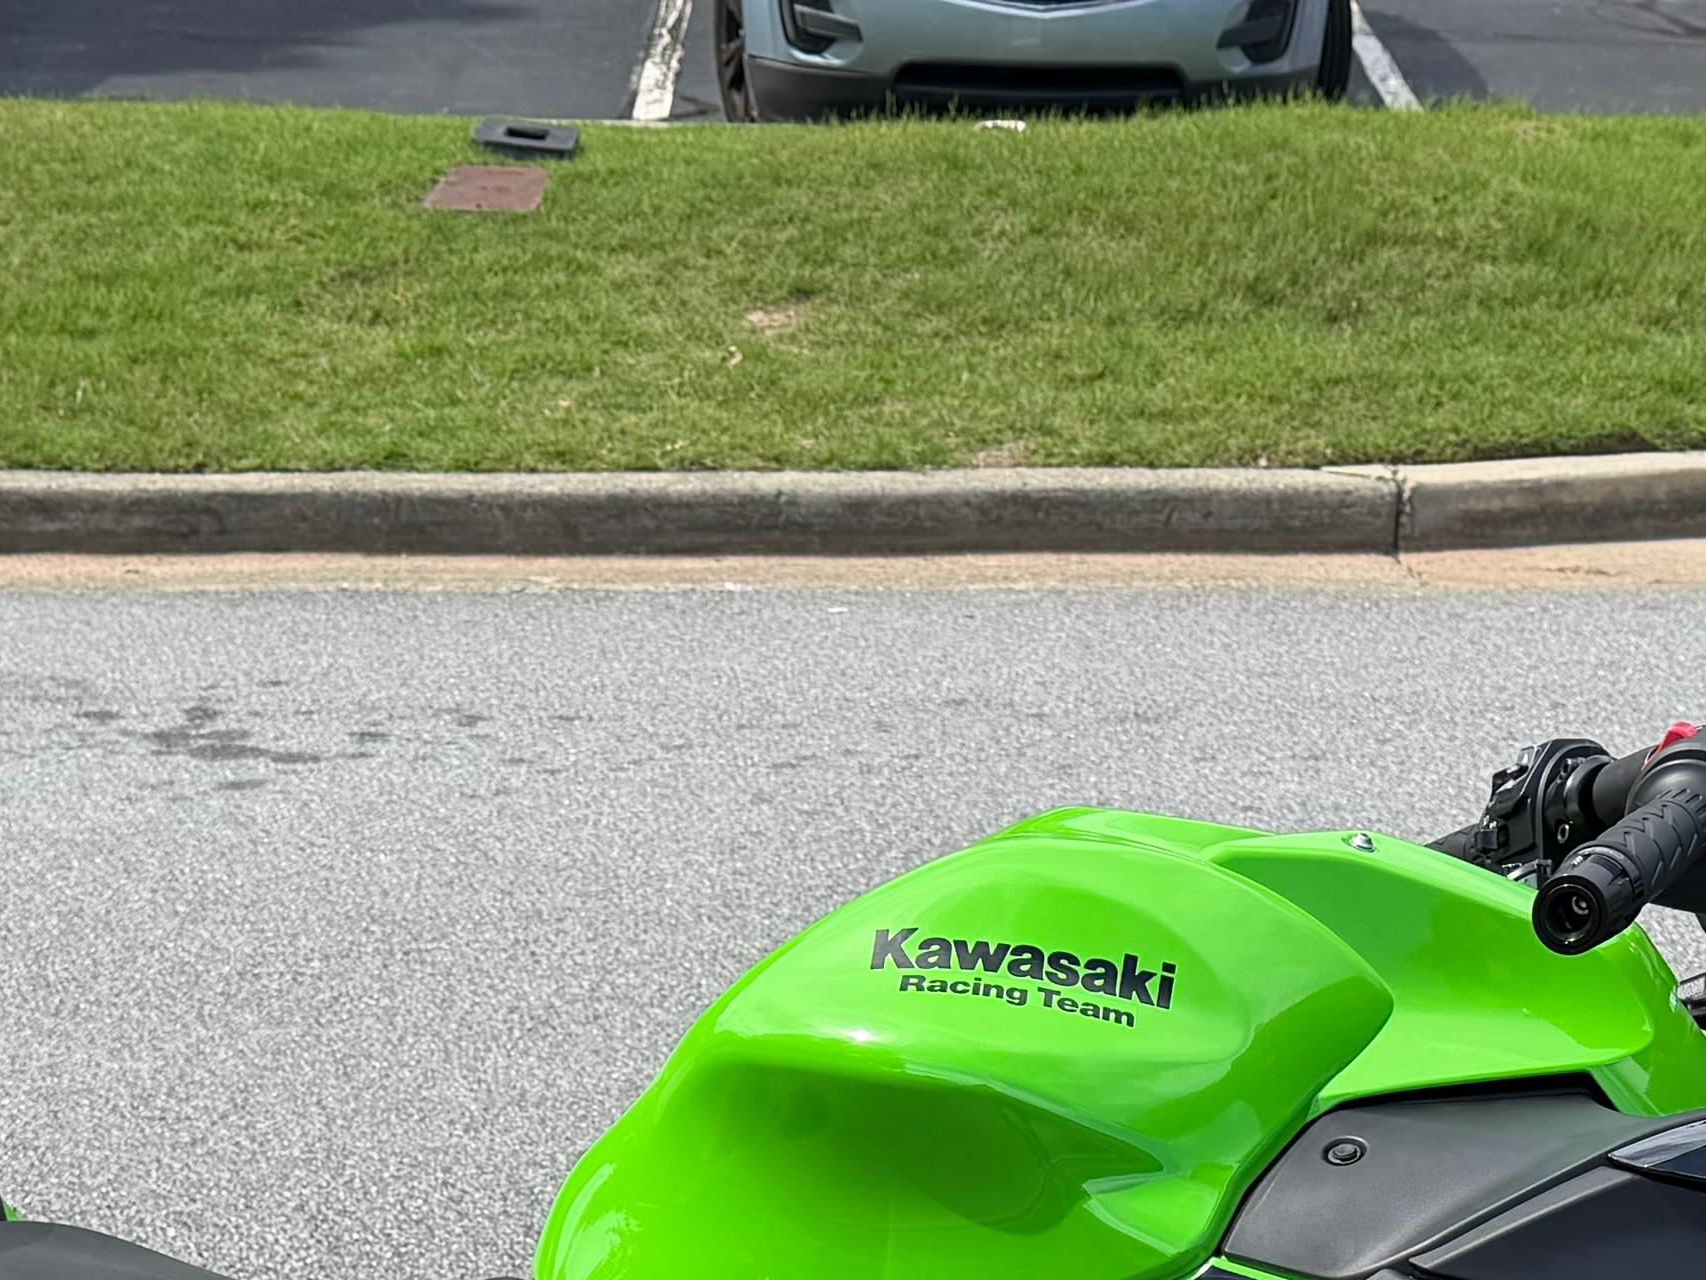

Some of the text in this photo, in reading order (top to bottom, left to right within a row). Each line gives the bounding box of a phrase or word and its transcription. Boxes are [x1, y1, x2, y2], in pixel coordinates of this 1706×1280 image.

[870, 927, 1176, 1010] Kawasaki
[899, 974, 1135, 1027] Racing Team
